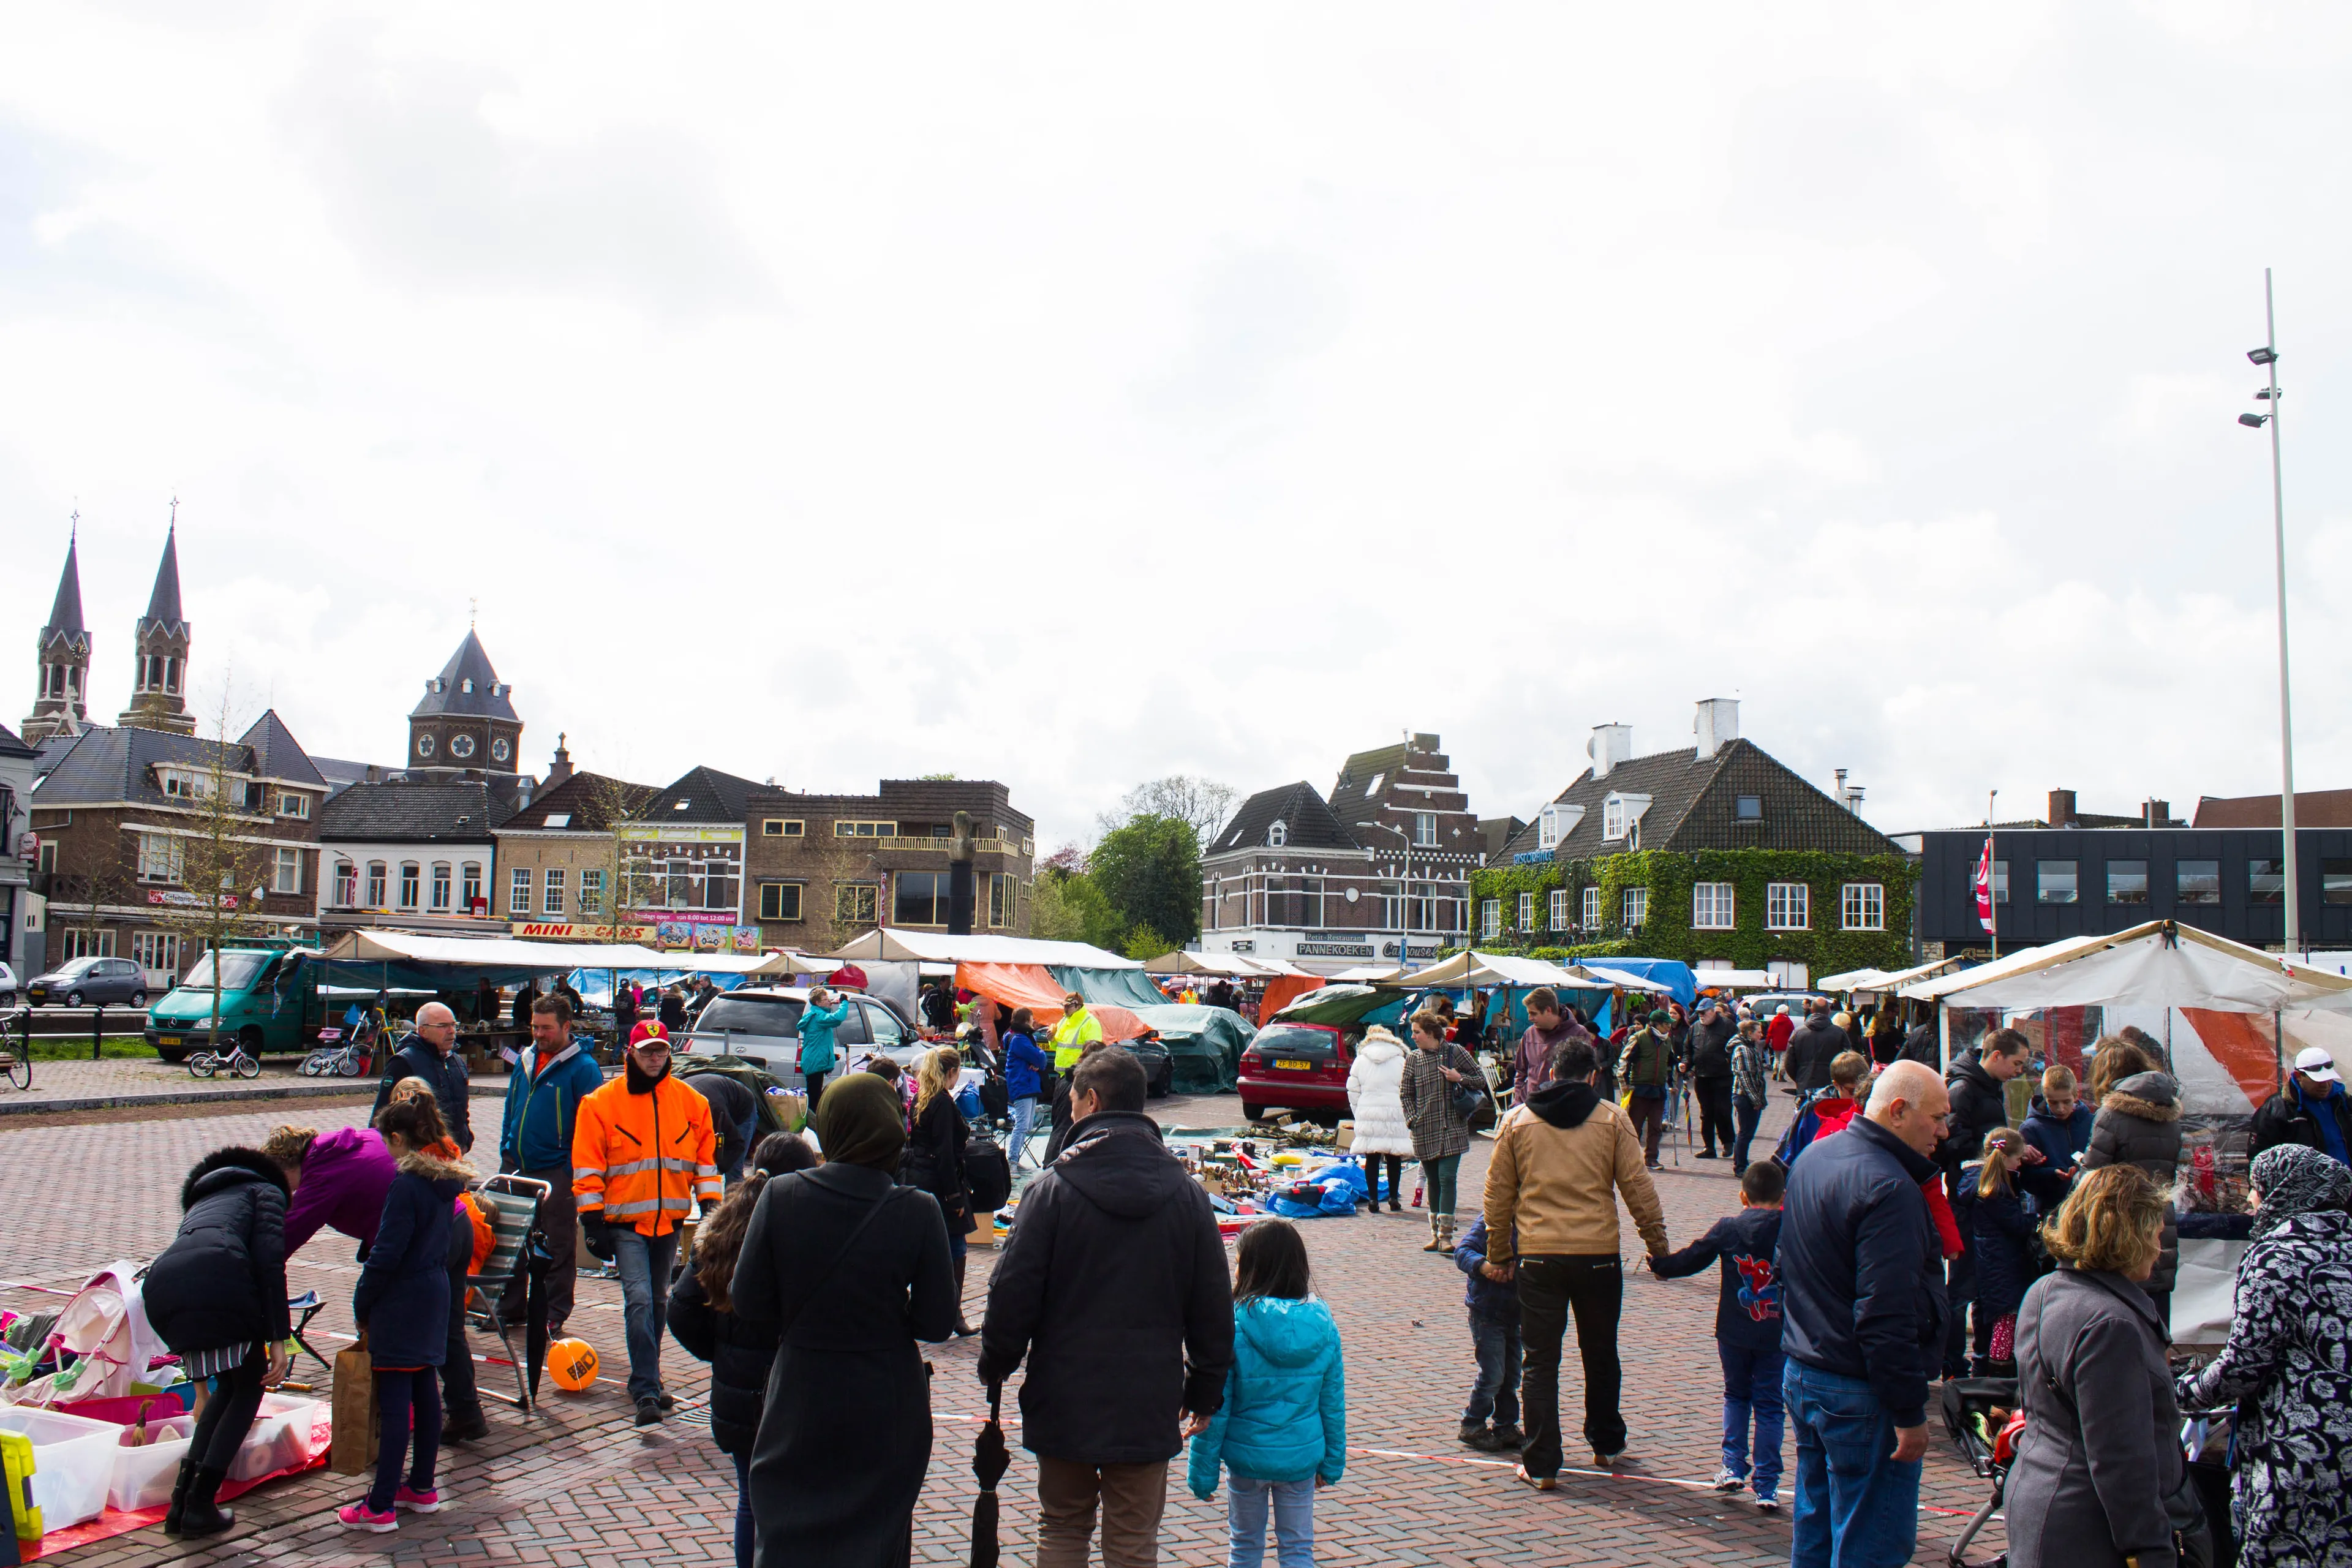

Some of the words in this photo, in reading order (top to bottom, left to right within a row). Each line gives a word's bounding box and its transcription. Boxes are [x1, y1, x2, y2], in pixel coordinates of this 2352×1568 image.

[522, 924, 573, 936] MINI
[594, 925, 645, 938] CARS
[1298, 944, 1373, 956] PANNEKOEKEN
[1384, 942, 1439, 957] Caousel
